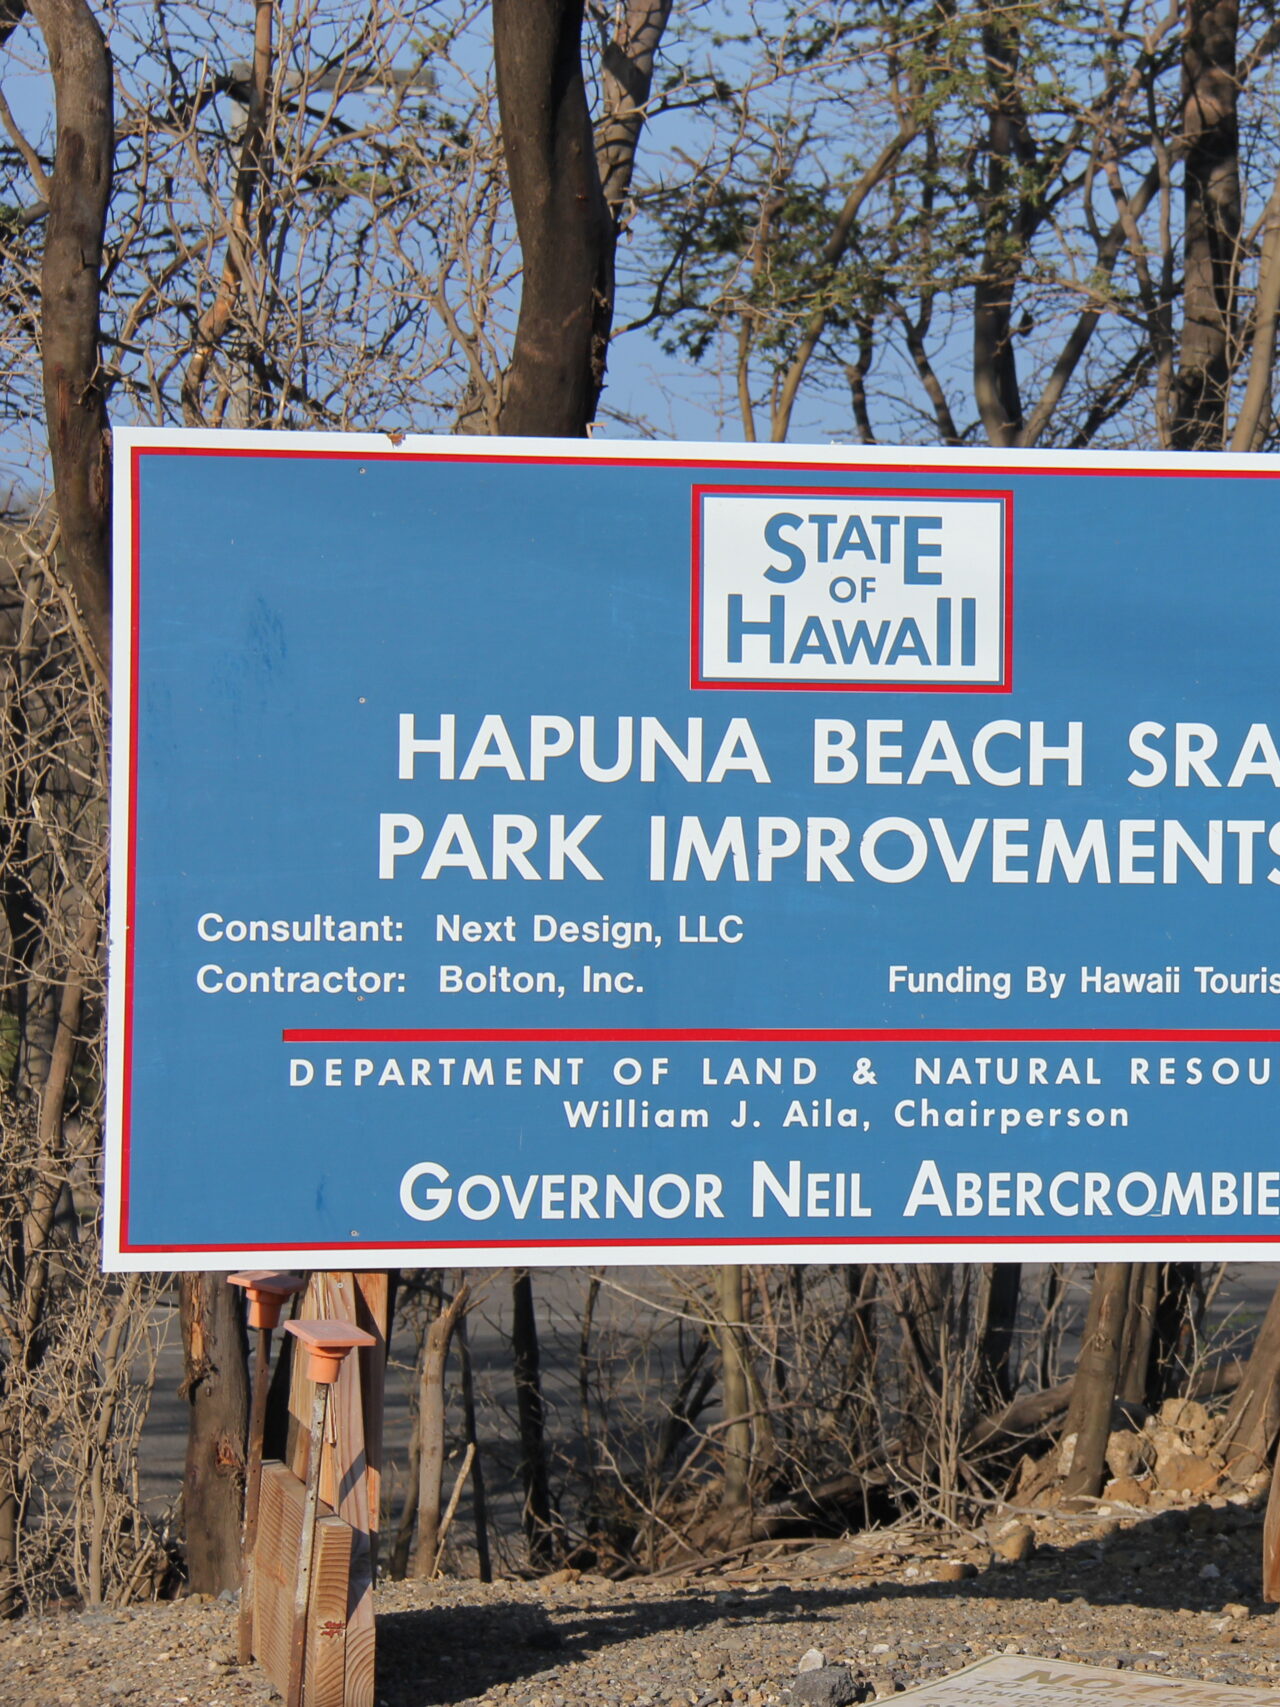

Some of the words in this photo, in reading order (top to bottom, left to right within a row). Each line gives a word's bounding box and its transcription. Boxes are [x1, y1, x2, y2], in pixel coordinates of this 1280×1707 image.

[764, 513, 942, 585] STATE
[830, 577, 875, 603] OF
[728, 593, 976, 666] HAWAII
[399, 714, 771, 783] HAPUNA
[814, 719, 1082, 786] BEACH
[379, 813, 603, 880] PARK
[198, 913, 402, 941] Consultant:
[437, 915, 515, 942] Next
[534, 915, 661, 948] Design,
[680, 915, 743, 943] LLC
[197, 965, 405, 993] Contractor:
[440, 966, 564, 998] Bolton,
[584, 966, 643, 993] Inc.
[890, 966, 1010, 999] Funding
[1027, 966, 1066, 998] By
[1082, 967, 1179, 993] Hawaii
[290, 1058, 583, 1086] DEPARTMENT
[614, 1058, 668, 1085] OF
[703, 1058, 816, 1085] LAND
[853, 1058, 877, 1084] &
[916, 1058, 1100, 1084] NATURAL
[564, 1099, 708, 1127] William
[731, 1101, 760, 1127] J.
[783, 1099, 869, 1131] Aila,
[895, 1099, 1128, 1134] Chairperson
[400, 1162, 724, 1221] GOVERNOR
[753, 1161, 871, 1217] NEIL
[903, 1160, 1279, 1216] ABERCROMBIE
[976, 1679, 1024, 1689] TO
